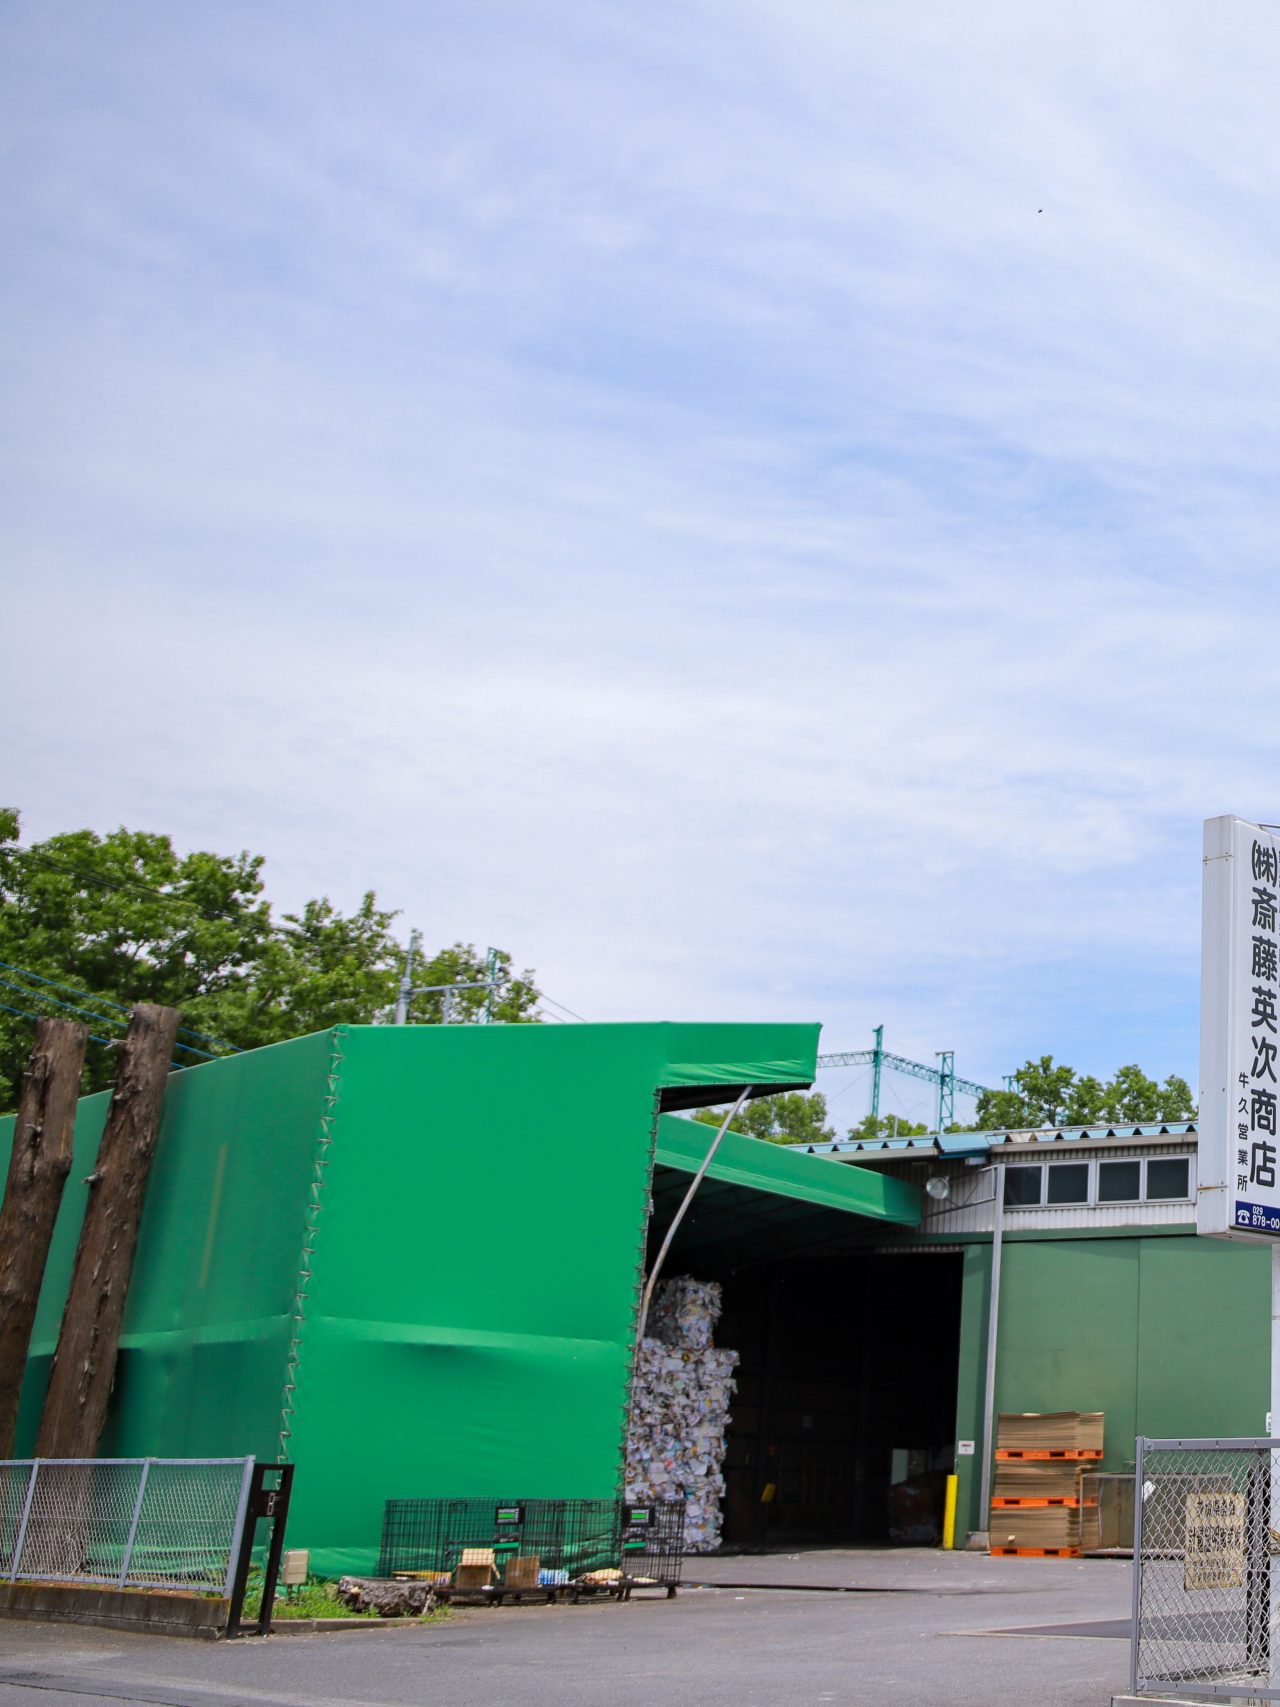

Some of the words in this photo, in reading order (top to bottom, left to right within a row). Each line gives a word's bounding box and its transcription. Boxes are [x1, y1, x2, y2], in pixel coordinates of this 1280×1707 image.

[1237, 1072, 1249, 1192] 牛久営業所
[1252, 1205, 1264, 1216] 029
